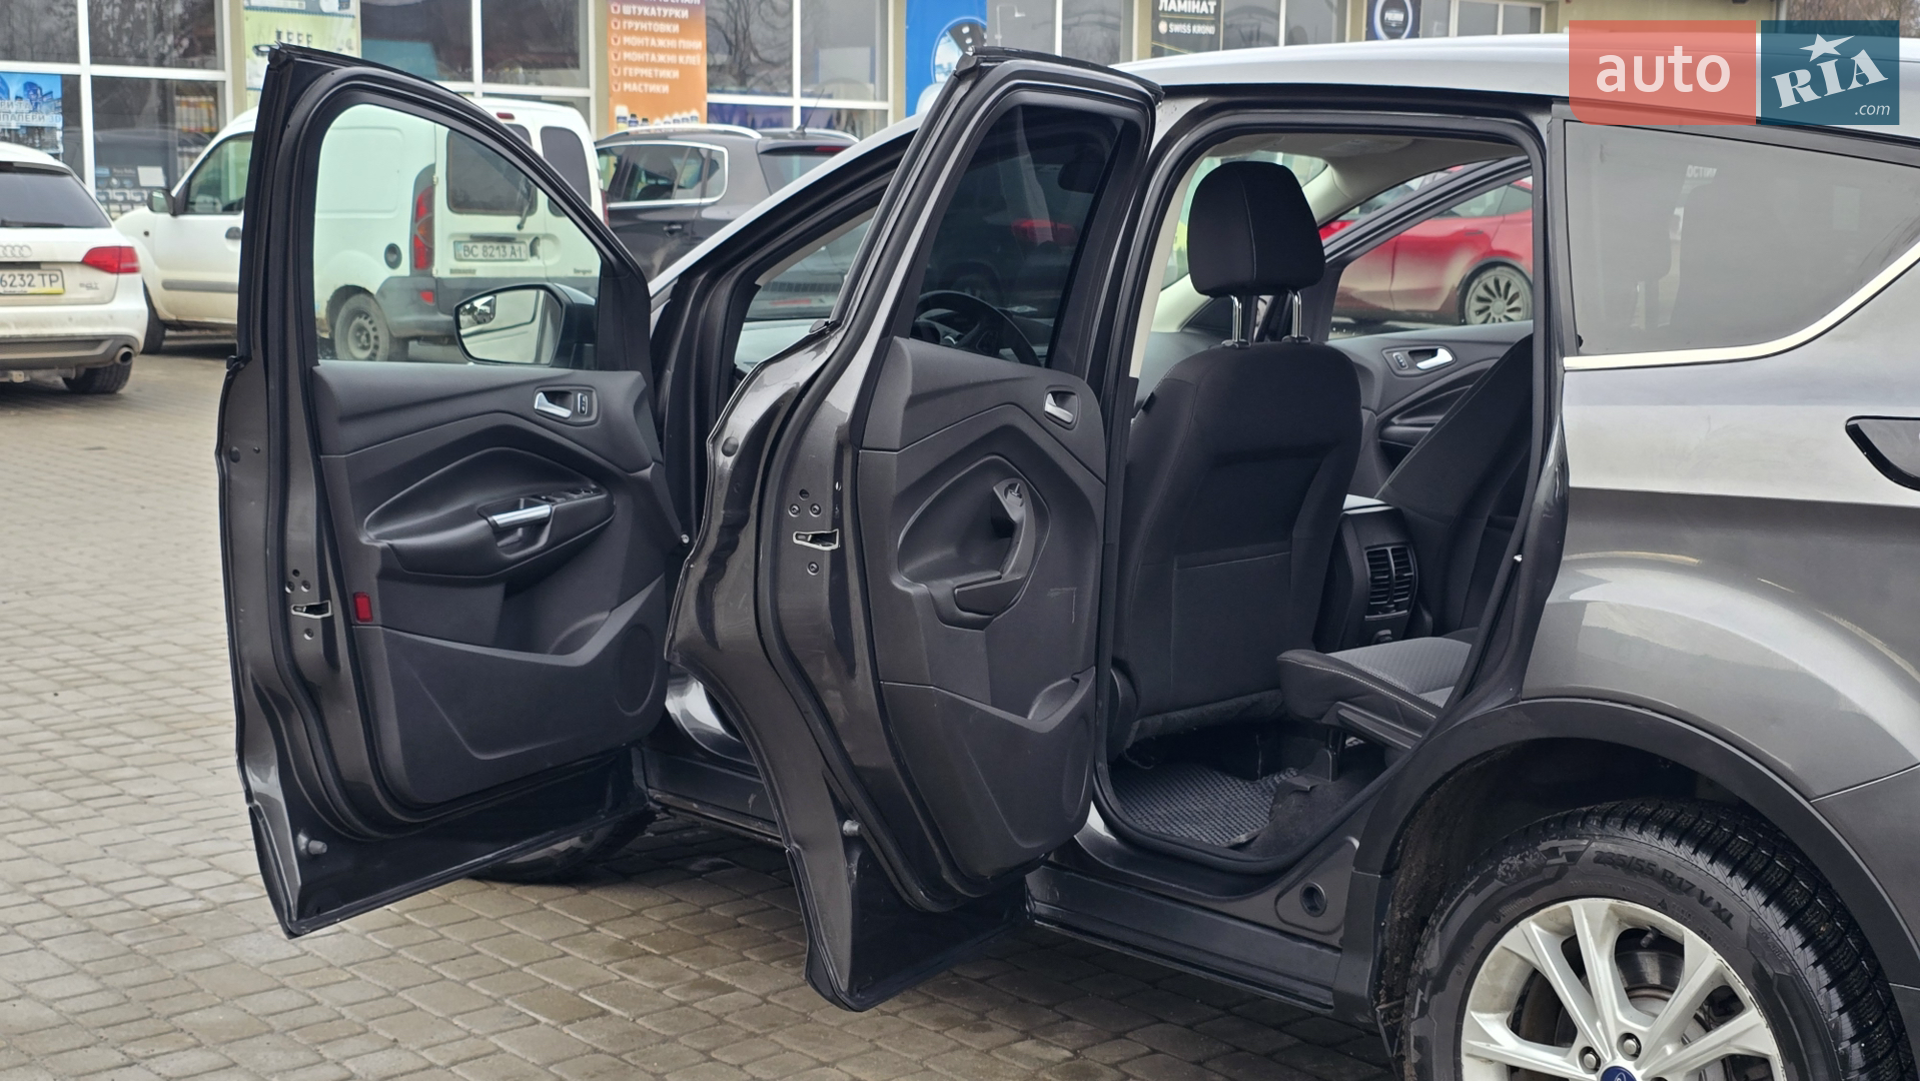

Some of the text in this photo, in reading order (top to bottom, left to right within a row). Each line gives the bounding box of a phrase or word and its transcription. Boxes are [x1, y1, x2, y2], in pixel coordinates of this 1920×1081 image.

[622, 5, 689, 19] ШТУКАТУРКИ
[622, 20, 680, 34] ГРУНТОВКИ
[1168, 22, 1191, 34] SWISS
[622, 36, 677, 49] МОНТАЖНІ
[622, 52, 677, 64] МОНТАЖНІ
[622, 67, 680, 80] ГЕРМЕТИКИ
[622, 82, 670, 94] МАСТИКИ
[463, 244, 479, 258] BC
[482, 245, 507, 259] 8213
[0, 272, 37, 289] 6232
[38, 272, 60, 289] TP
